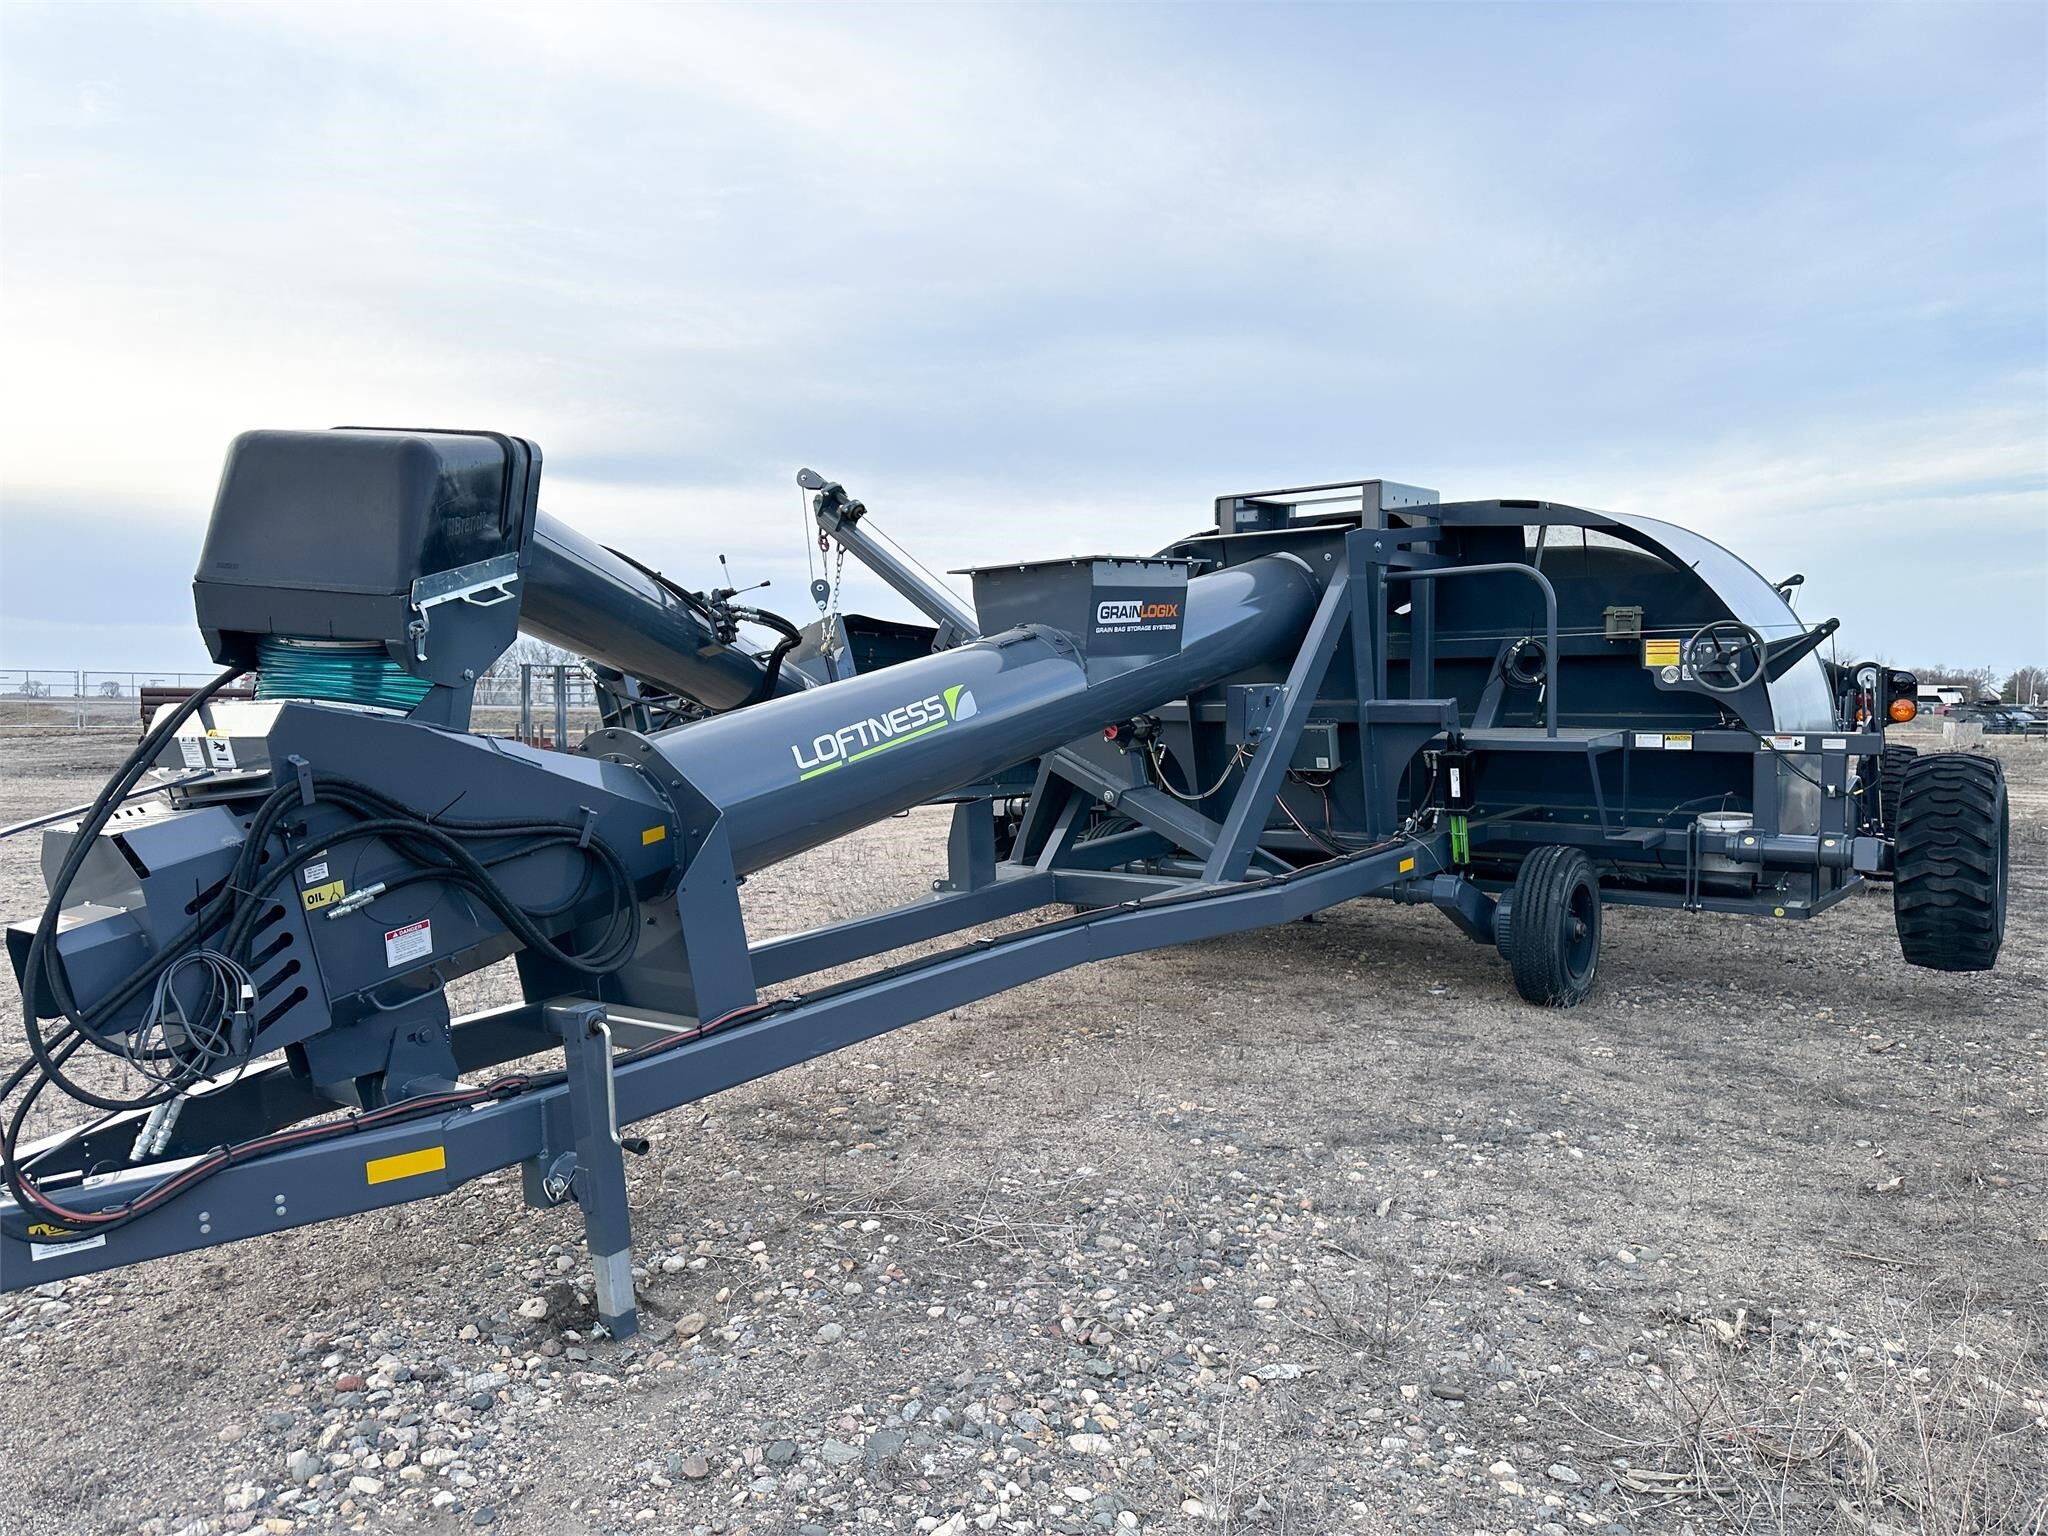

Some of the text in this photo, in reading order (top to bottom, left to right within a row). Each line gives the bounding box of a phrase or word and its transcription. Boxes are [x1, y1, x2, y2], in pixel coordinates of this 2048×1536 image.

[1100, 604, 1179, 620] GRAINLOGIX
[1096, 626, 1113, 634] GRAIN
[1114, 625, 1126, 633] BAG
[1152, 623, 1177, 631] SYSTEMS
[791, 694, 946, 769] LOFTNESS
[307, 893, 325, 904] OIL
[398, 924, 423, 936] DANGER
